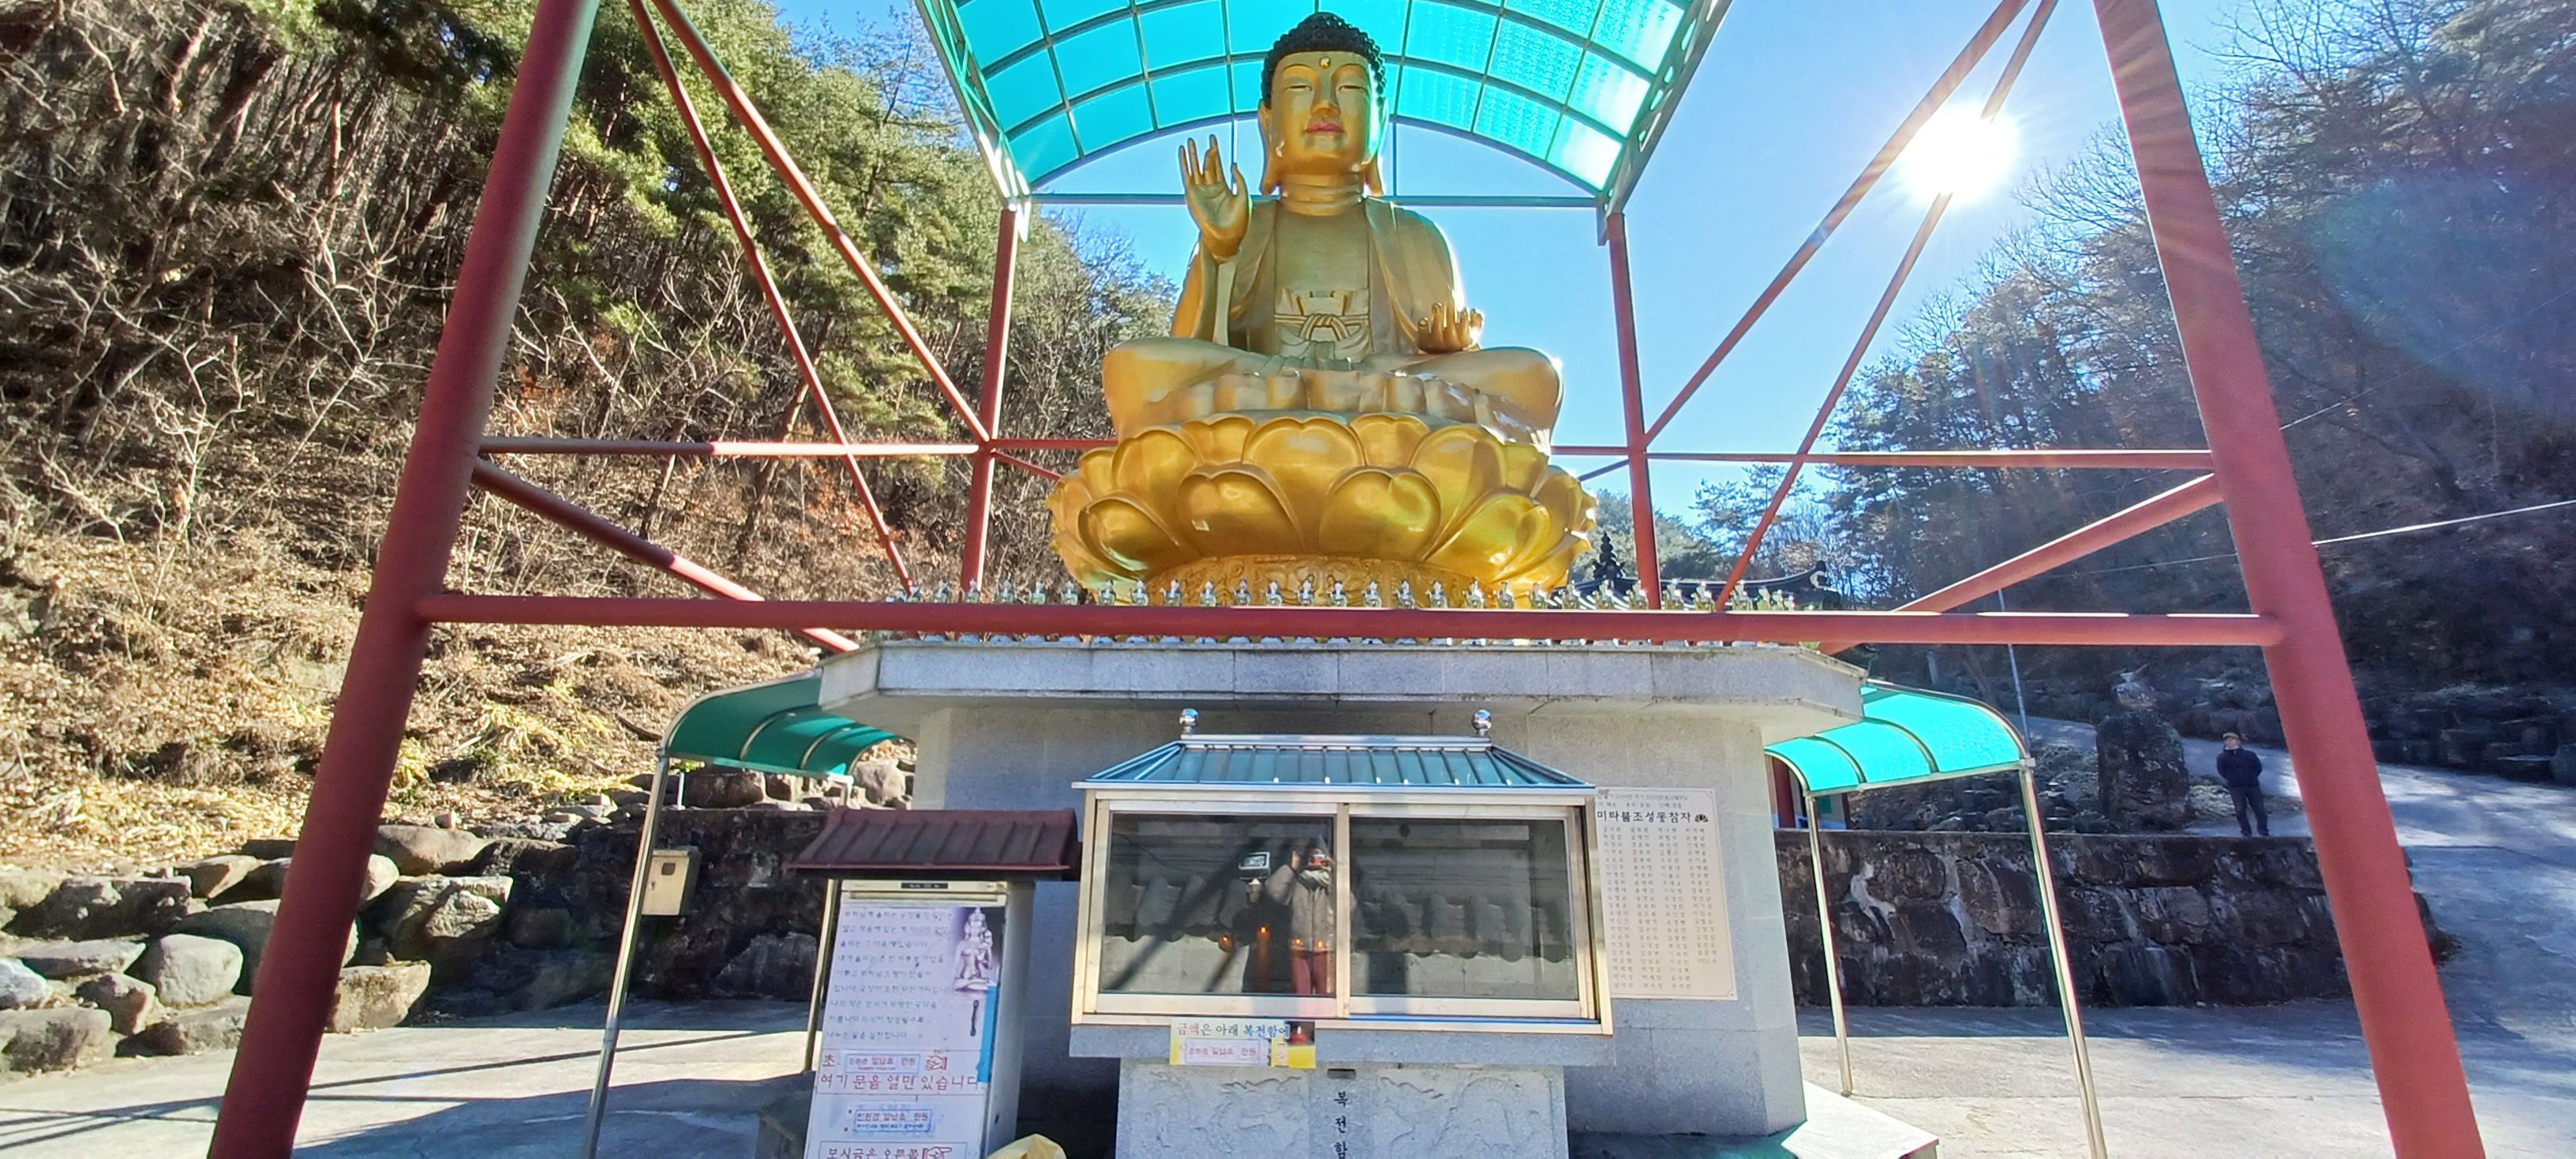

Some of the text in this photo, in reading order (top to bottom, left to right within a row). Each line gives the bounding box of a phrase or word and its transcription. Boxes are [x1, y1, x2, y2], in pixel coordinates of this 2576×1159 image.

[1177, 1023, 1290, 1038] 금액은 아래 복전함에
[821, 1075, 848, 1089] 여기
[853, 1075, 882, 1090] 문을
[887, 1075, 915, 1090] 열면
[1334, 1091, 1348, 1159] 복전함
